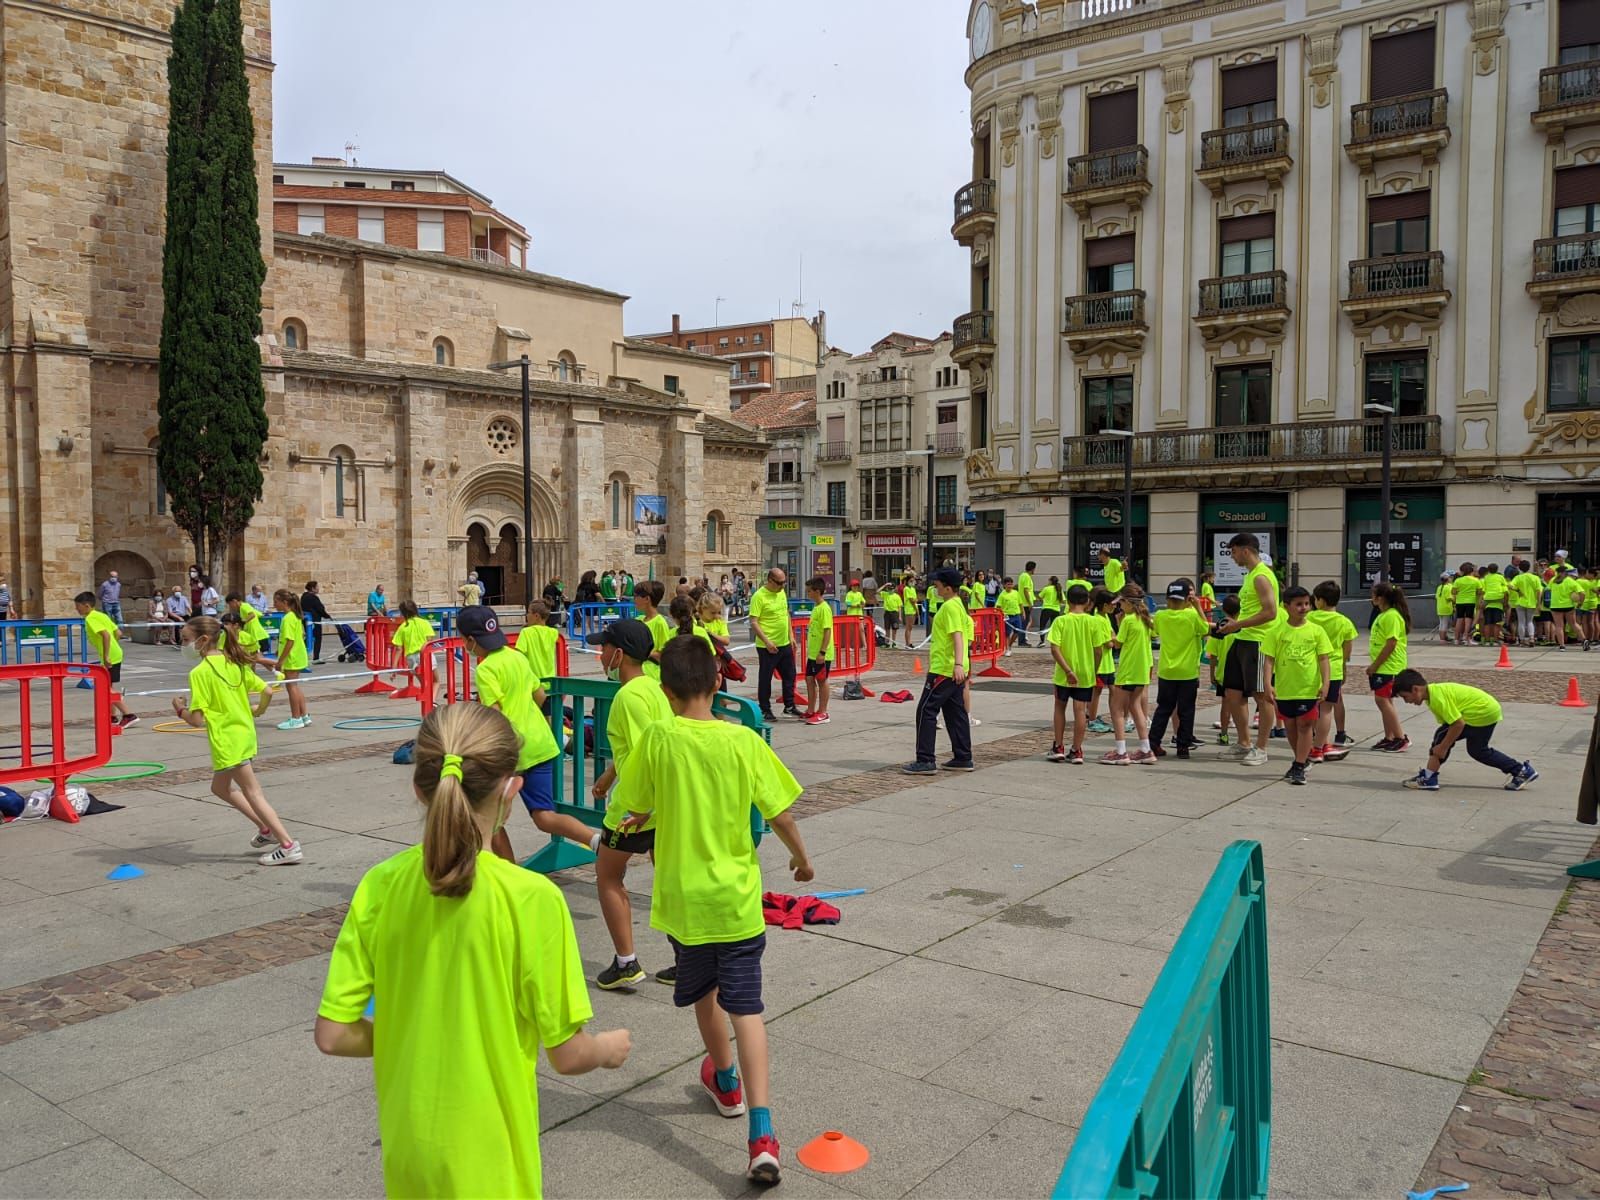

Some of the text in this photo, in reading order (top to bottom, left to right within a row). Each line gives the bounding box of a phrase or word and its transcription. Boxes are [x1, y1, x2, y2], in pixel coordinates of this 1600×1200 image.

[1089, 541, 1121, 549] Cuenta
[1366, 541, 1405, 550] Cunta
[1089, 569, 1105, 577] tod
